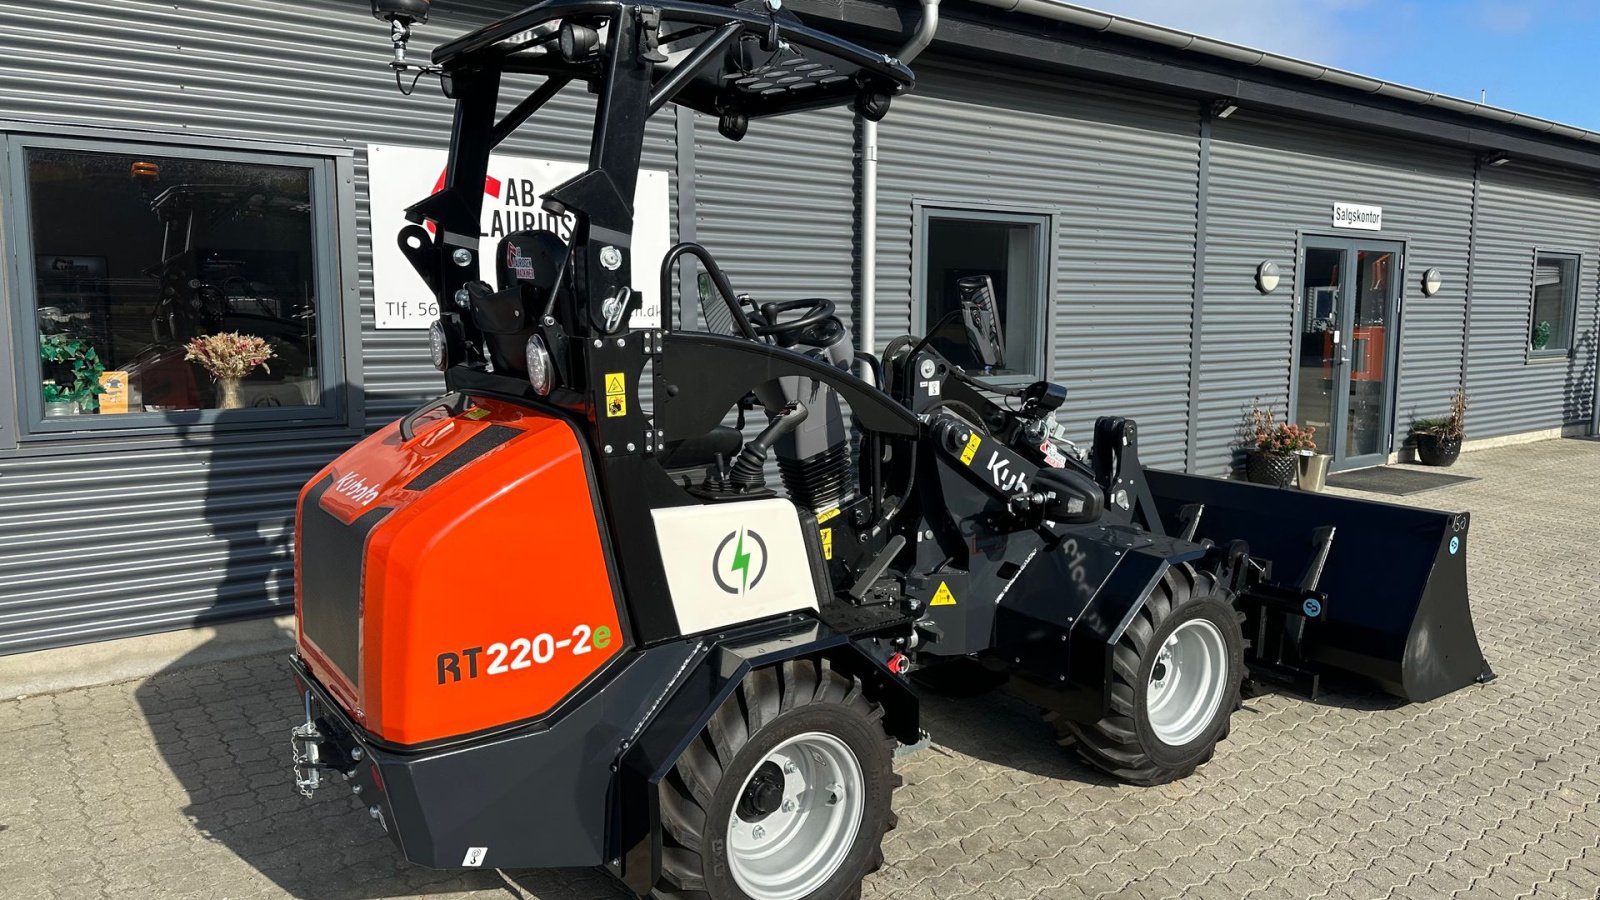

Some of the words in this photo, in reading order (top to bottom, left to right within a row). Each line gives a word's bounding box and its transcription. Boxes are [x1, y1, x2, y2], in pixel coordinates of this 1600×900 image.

[505, 178, 535, 207] AB
[1335, 207, 1380, 225] Salgskontor
[385, 301, 412, 320] Tlf.
[336, 471, 380, 506] Kubota
